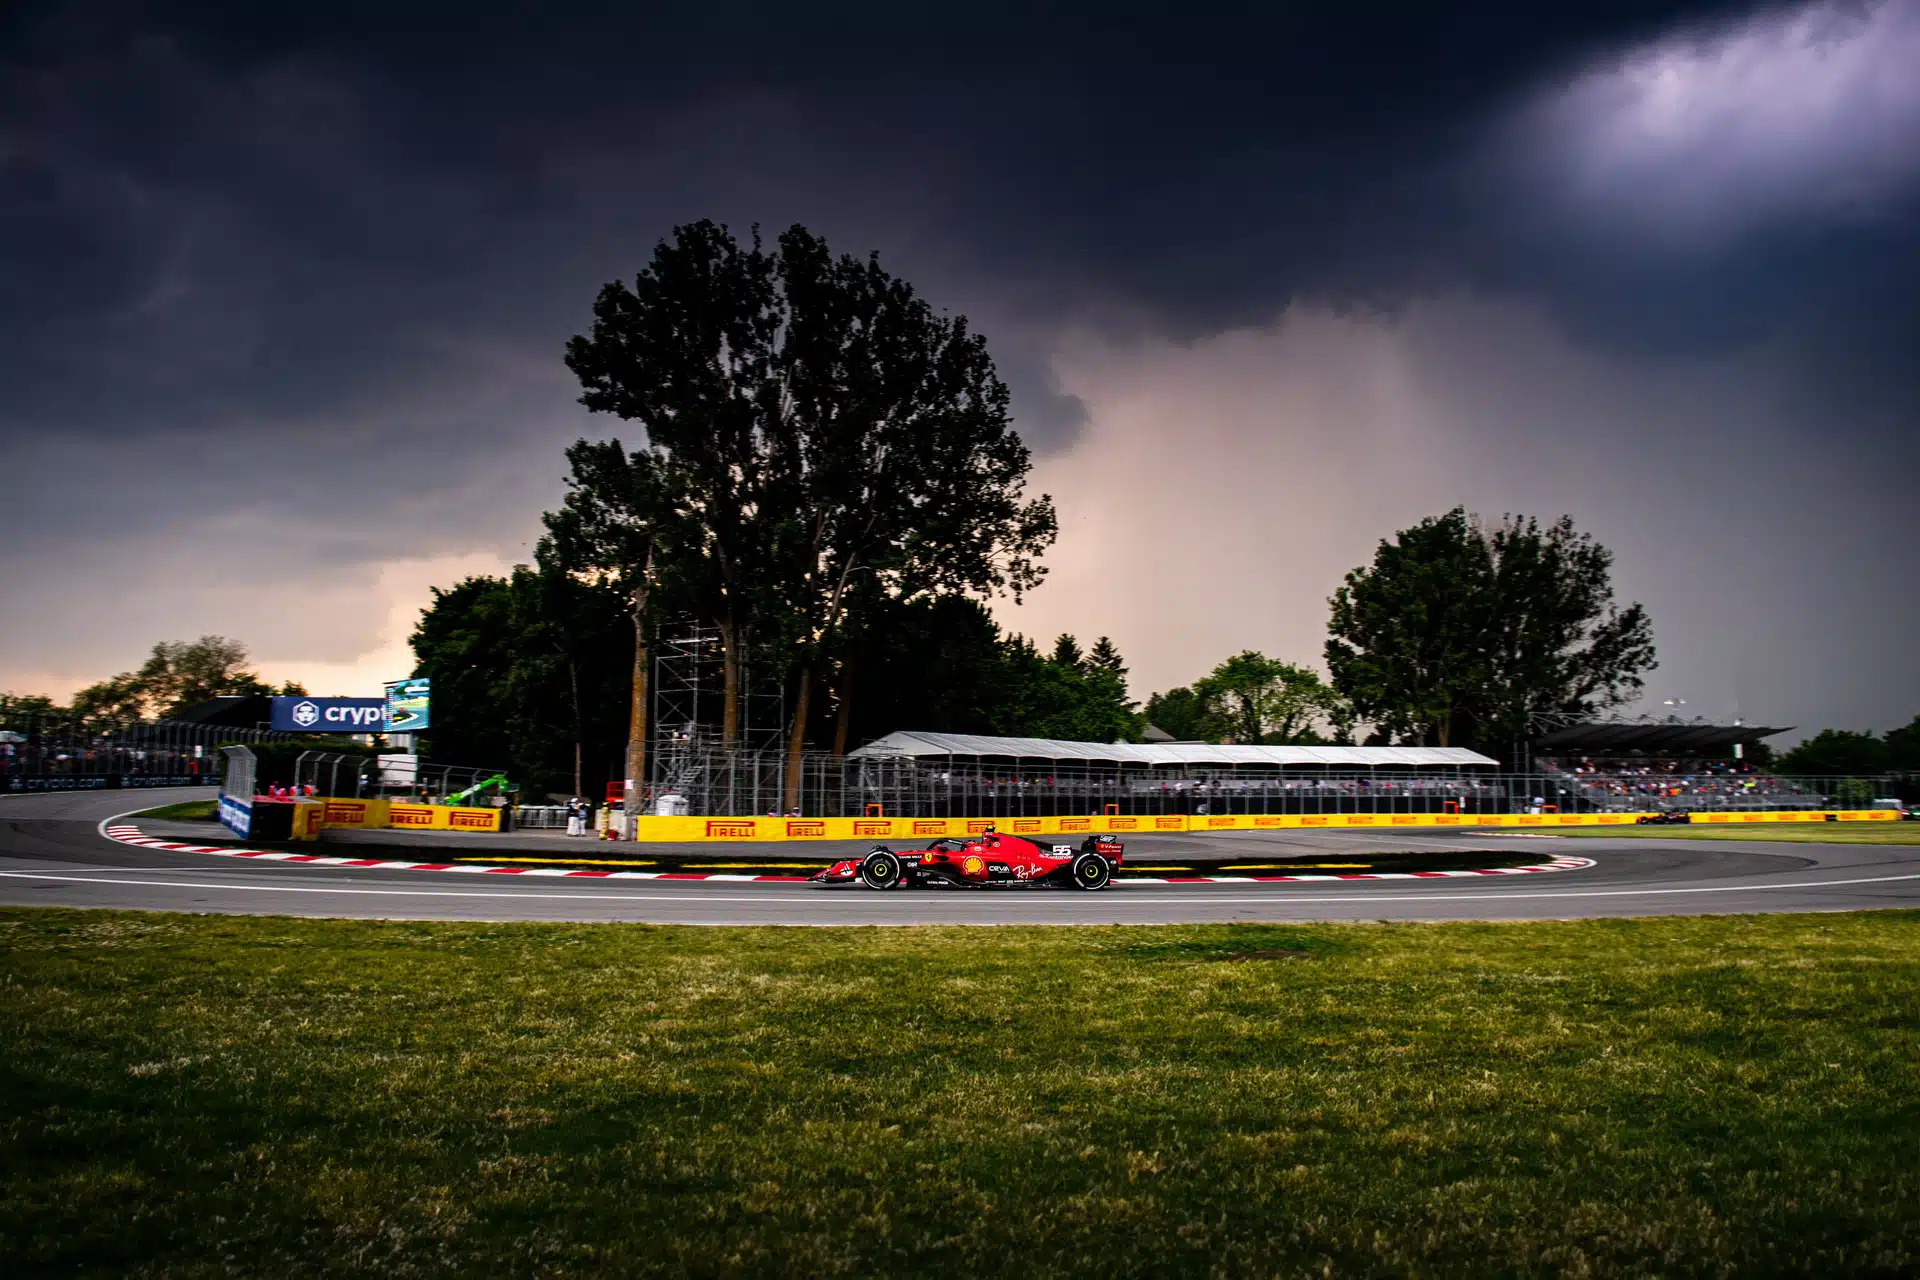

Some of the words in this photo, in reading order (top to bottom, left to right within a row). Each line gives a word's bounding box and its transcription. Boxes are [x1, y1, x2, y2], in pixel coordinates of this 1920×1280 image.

[450, 812, 493, 827] PIRELLI
[706, 821, 755, 837] PIRELLI
[786, 821, 825, 837] PIRELLI
[853, 821, 891, 835] PIRELLI
[914, 821, 947, 834] PIRELLI
[1053, 845, 1071, 855] 55
[1013, 862, 1043, 879] Ray-Ban
